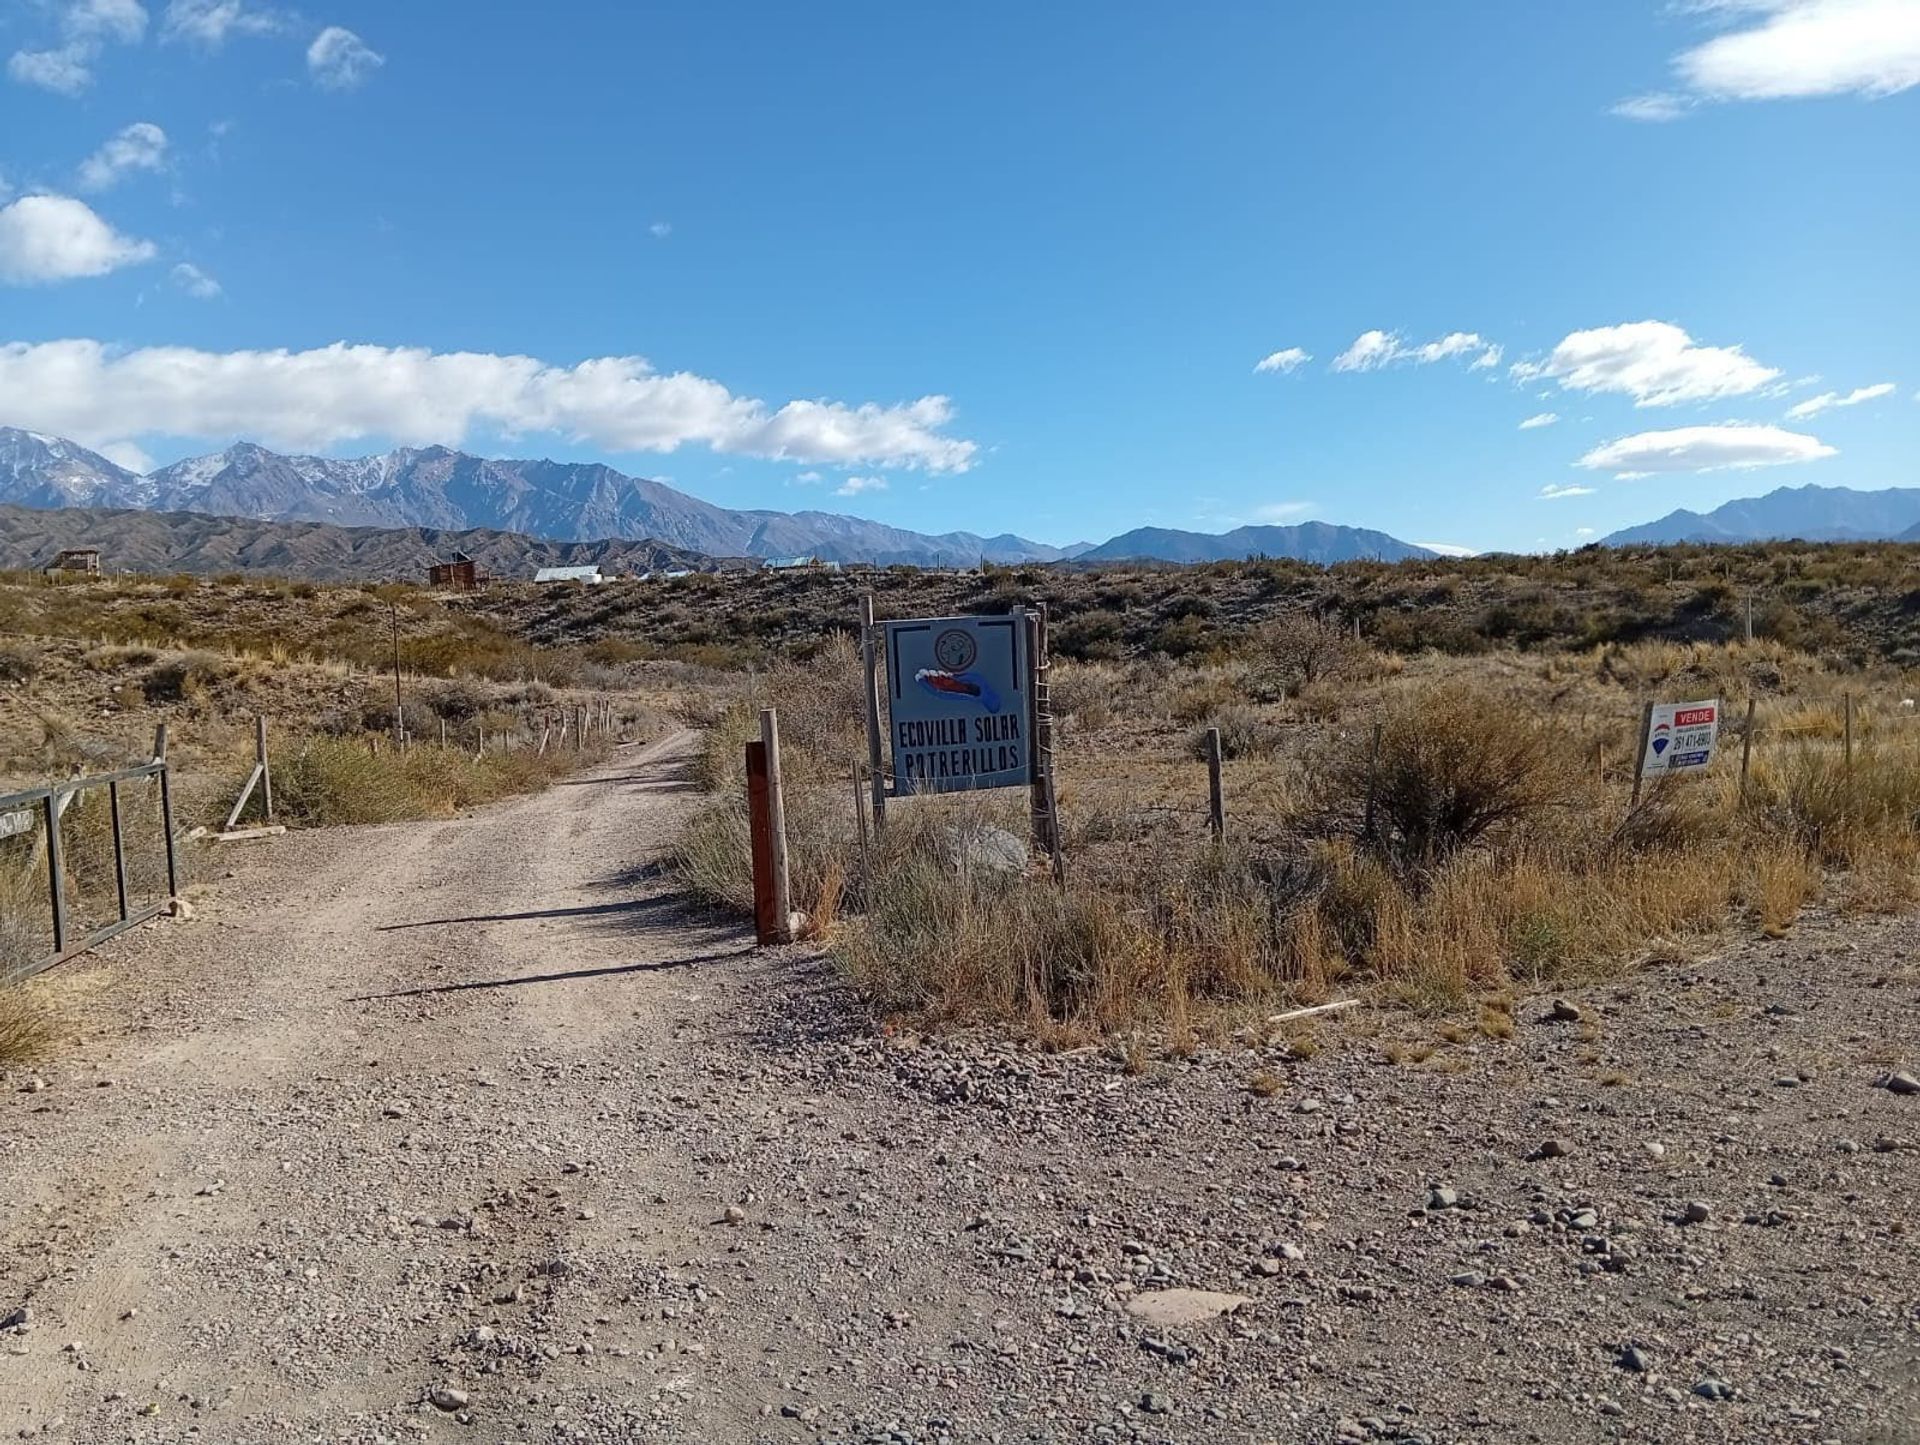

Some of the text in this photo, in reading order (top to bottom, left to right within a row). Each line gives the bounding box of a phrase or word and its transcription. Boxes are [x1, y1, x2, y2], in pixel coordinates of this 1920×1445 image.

[899, 714, 1020, 748] ECOVILLA SOLAR
[1680, 710, 1710, 724] VENDE
[905, 745, 1020, 778] POTRERILLOS
